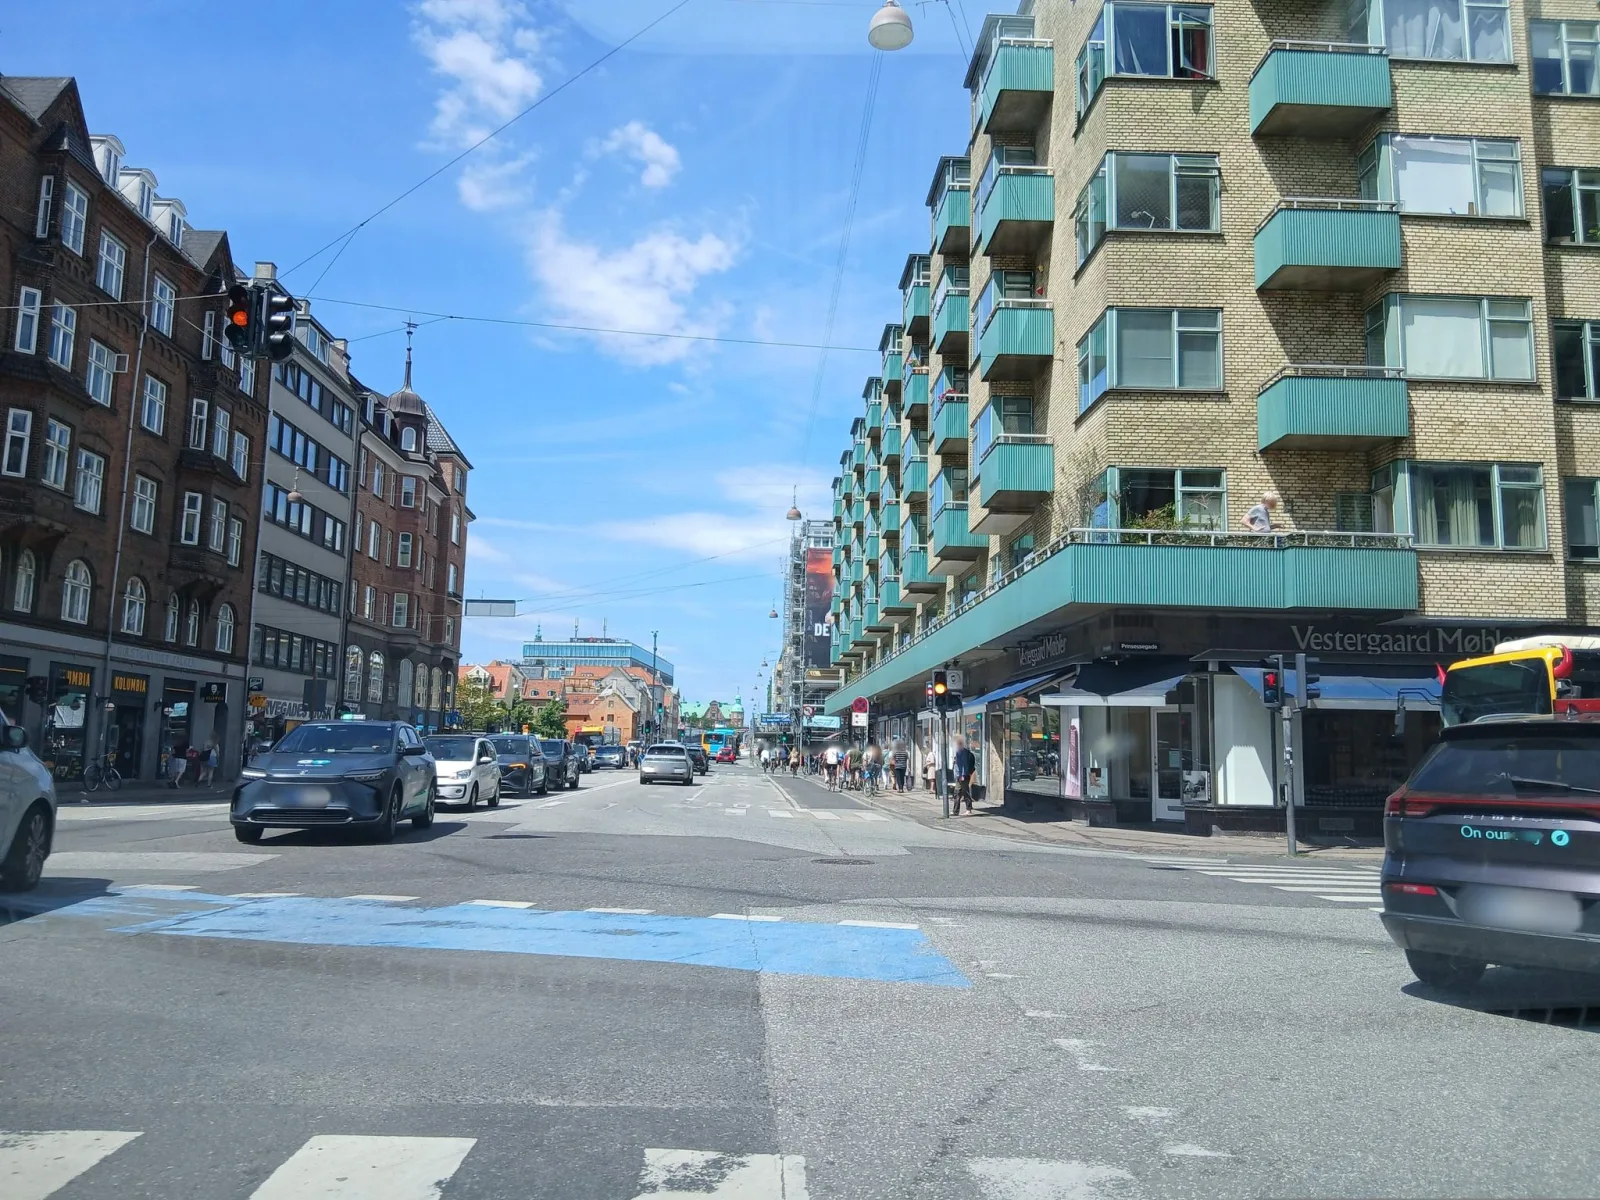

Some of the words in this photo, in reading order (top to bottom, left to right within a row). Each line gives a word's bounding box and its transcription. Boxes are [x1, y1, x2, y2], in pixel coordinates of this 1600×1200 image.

[1121, 643, 1158, 651] Prinsessegade
[1289, 625, 1431, 655] Vestergaard
[1436, 627, 1524, 653] Møbl
[114, 675, 146, 693] KOLUMBIA
[1460, 825, 1482, 838] On
